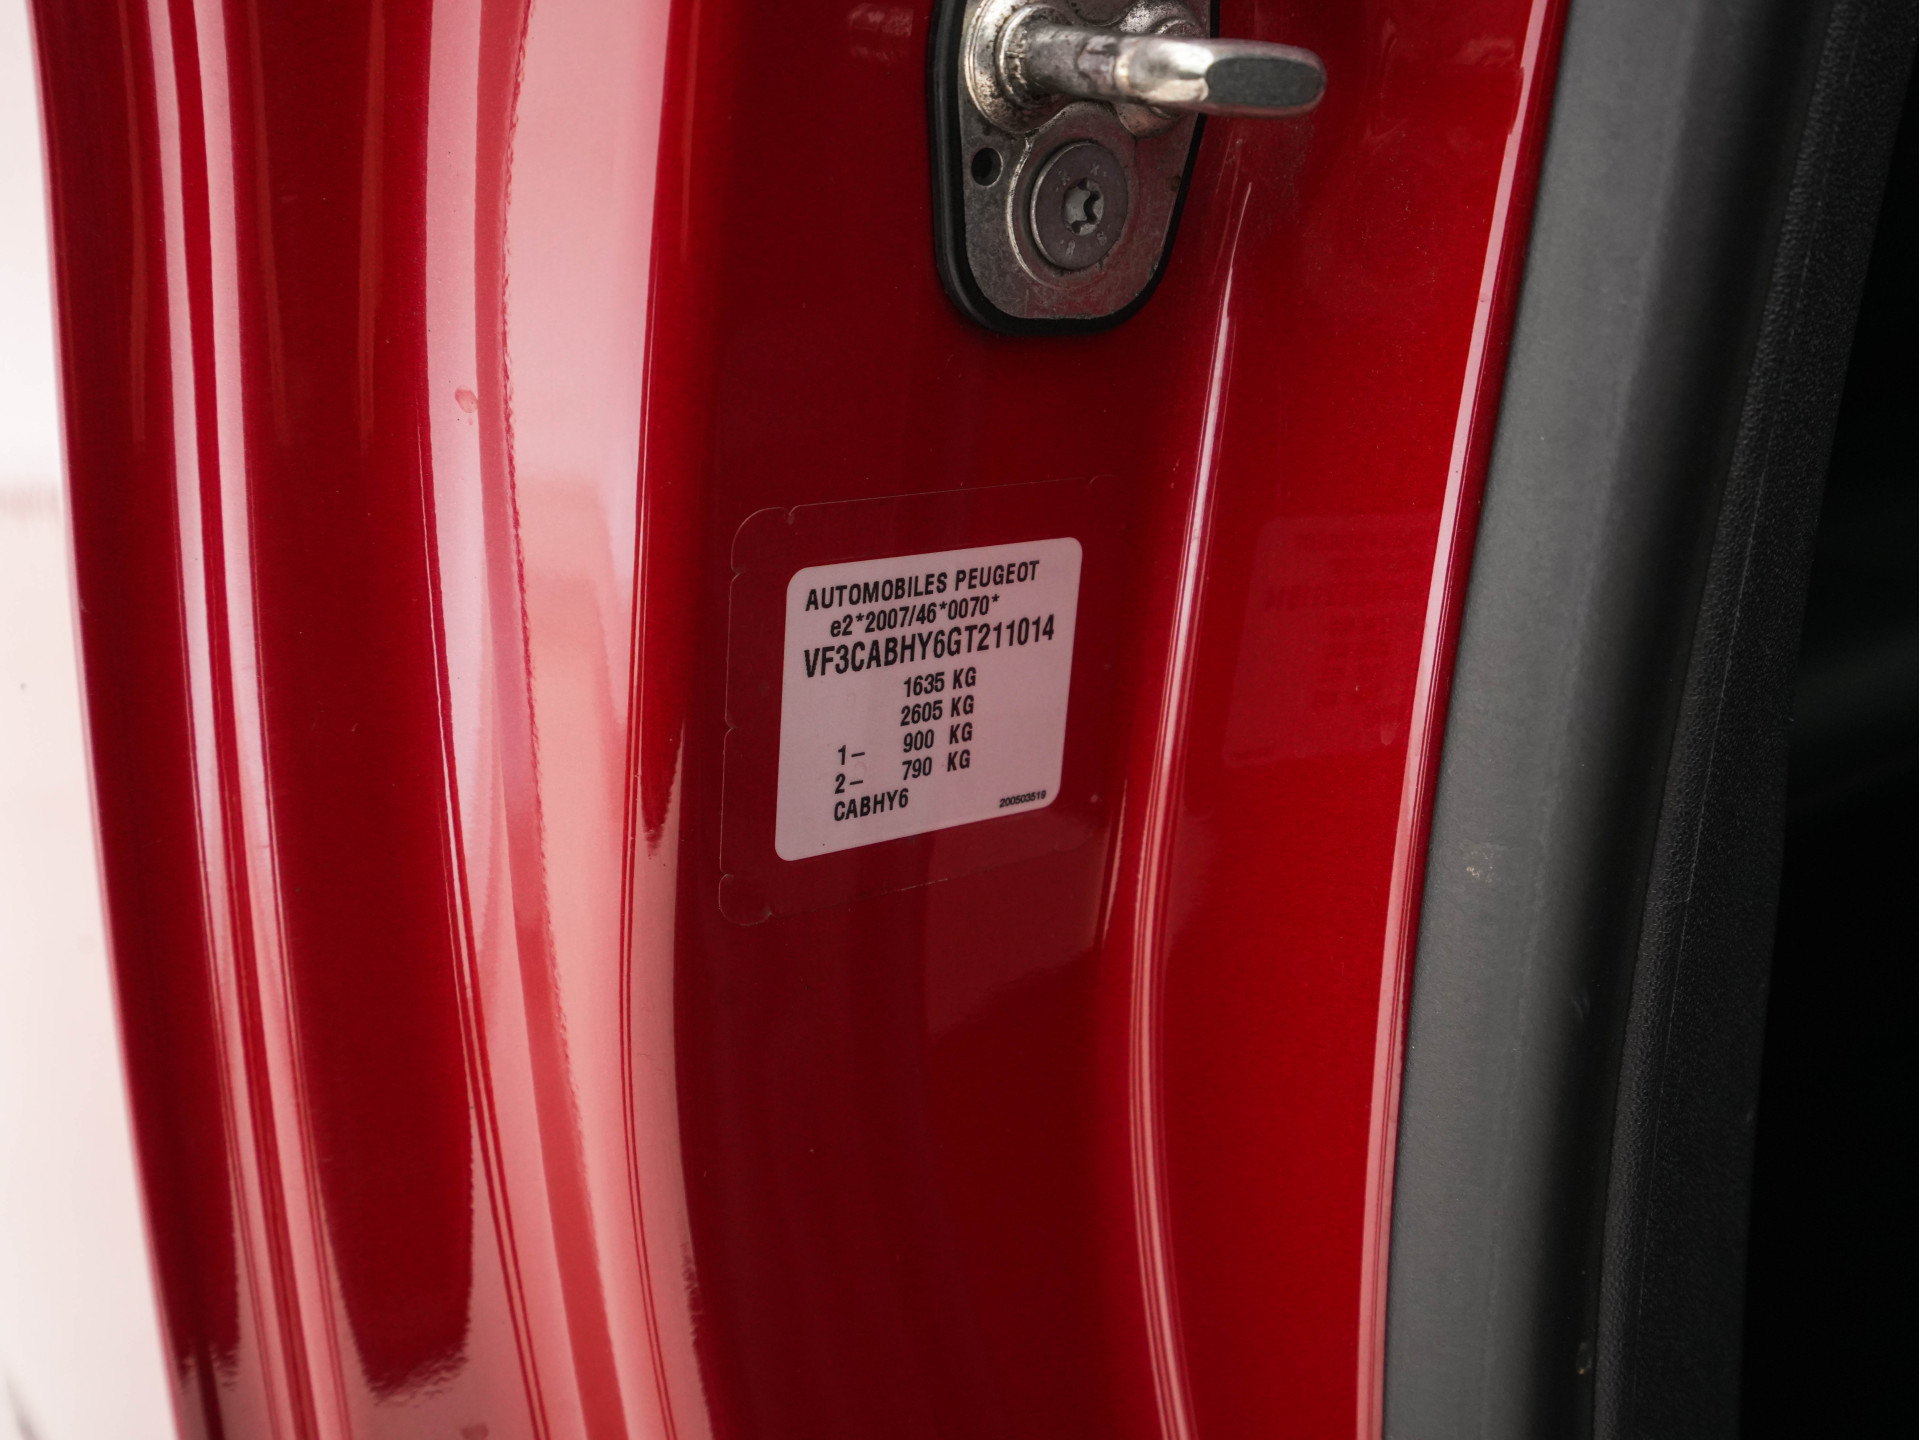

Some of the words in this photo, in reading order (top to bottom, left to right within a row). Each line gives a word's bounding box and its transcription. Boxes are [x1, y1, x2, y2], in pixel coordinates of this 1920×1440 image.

[805, 572, 948, 611] AUTOMOBILES
[955, 560, 1040, 591] PEUGEOT
[804, 614, 1055, 678] VF3CABHY6GT211014
[904, 672, 945, 697] 1635
[952, 667, 977, 690] KG
[901, 700, 942, 726] 2605
[950, 695, 974, 718] KG
[903, 729, 934, 752] 900
[949, 722, 973, 745] KG
[902, 757, 932, 780] 790
[947, 749, 971, 772] KG
[834, 788, 909, 821] CABHY6
[999, 790, 1047, 808] 200503519
